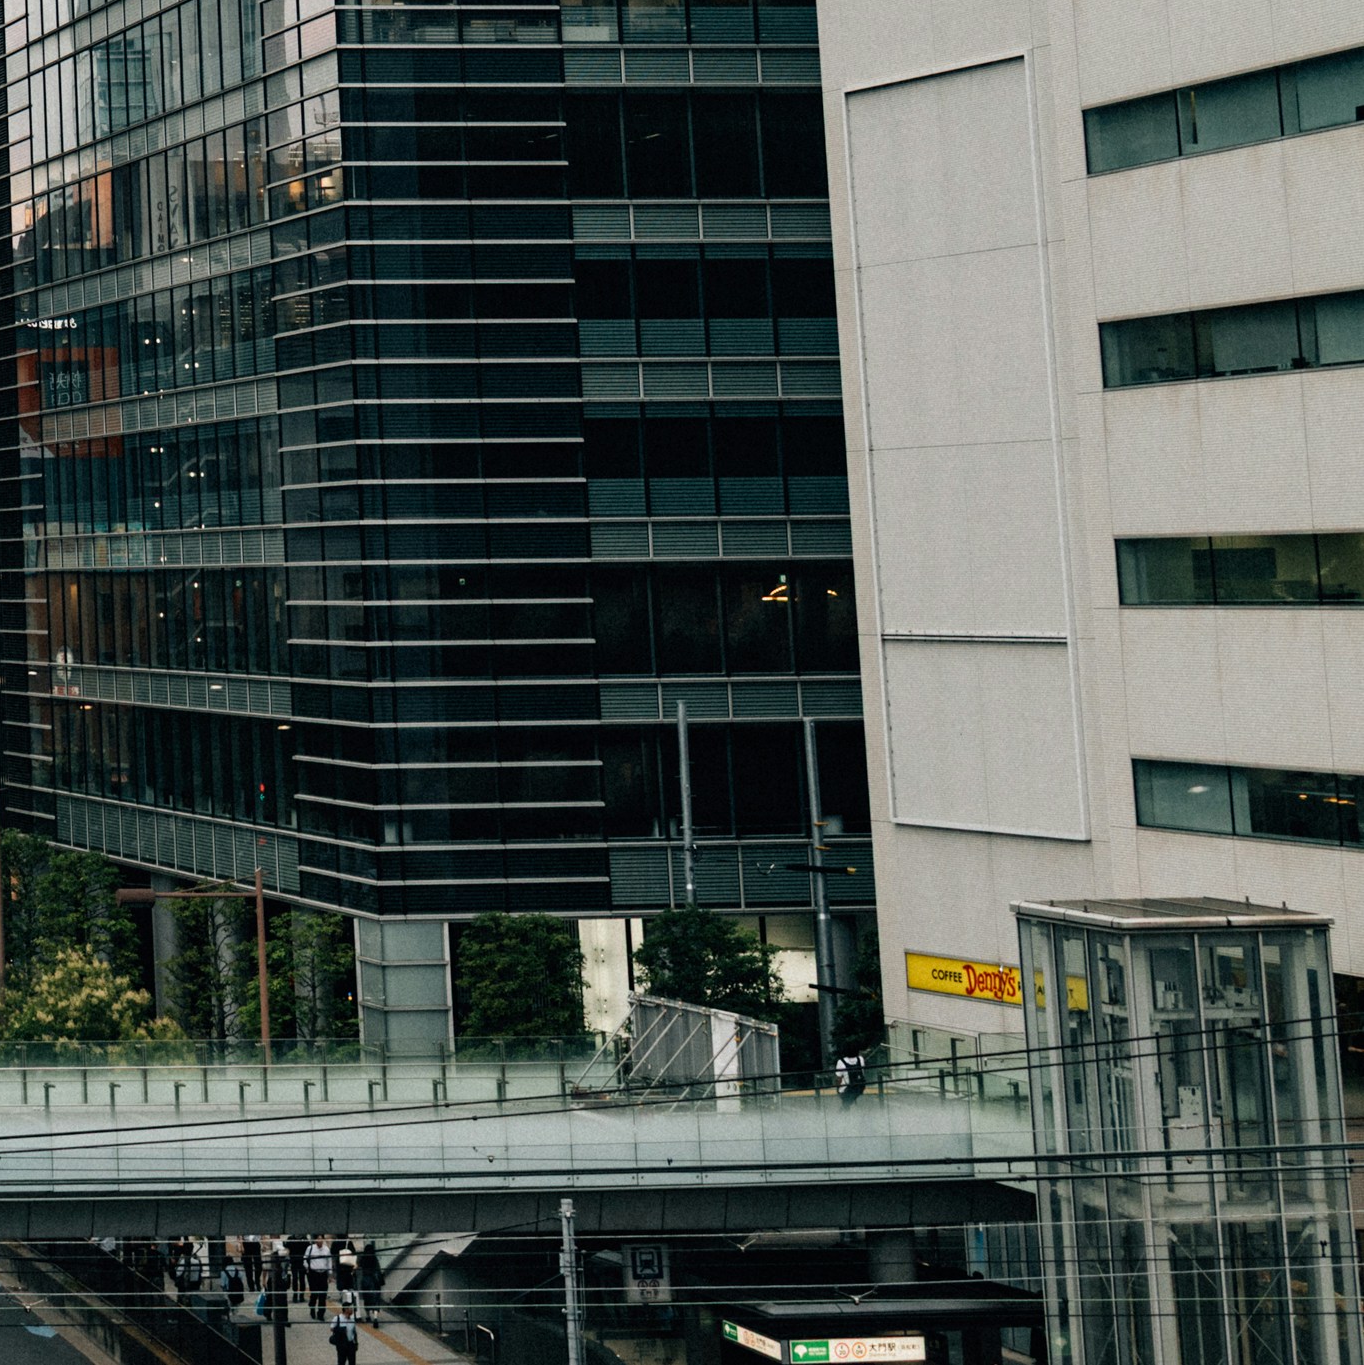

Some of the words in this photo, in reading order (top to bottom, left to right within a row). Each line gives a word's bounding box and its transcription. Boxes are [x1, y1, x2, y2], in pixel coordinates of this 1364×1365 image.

[931, 968, 963, 984] COFFEE
[962, 964, 1016, 1002] Denny's
[869, 1342, 896, 1352] 大門駅
